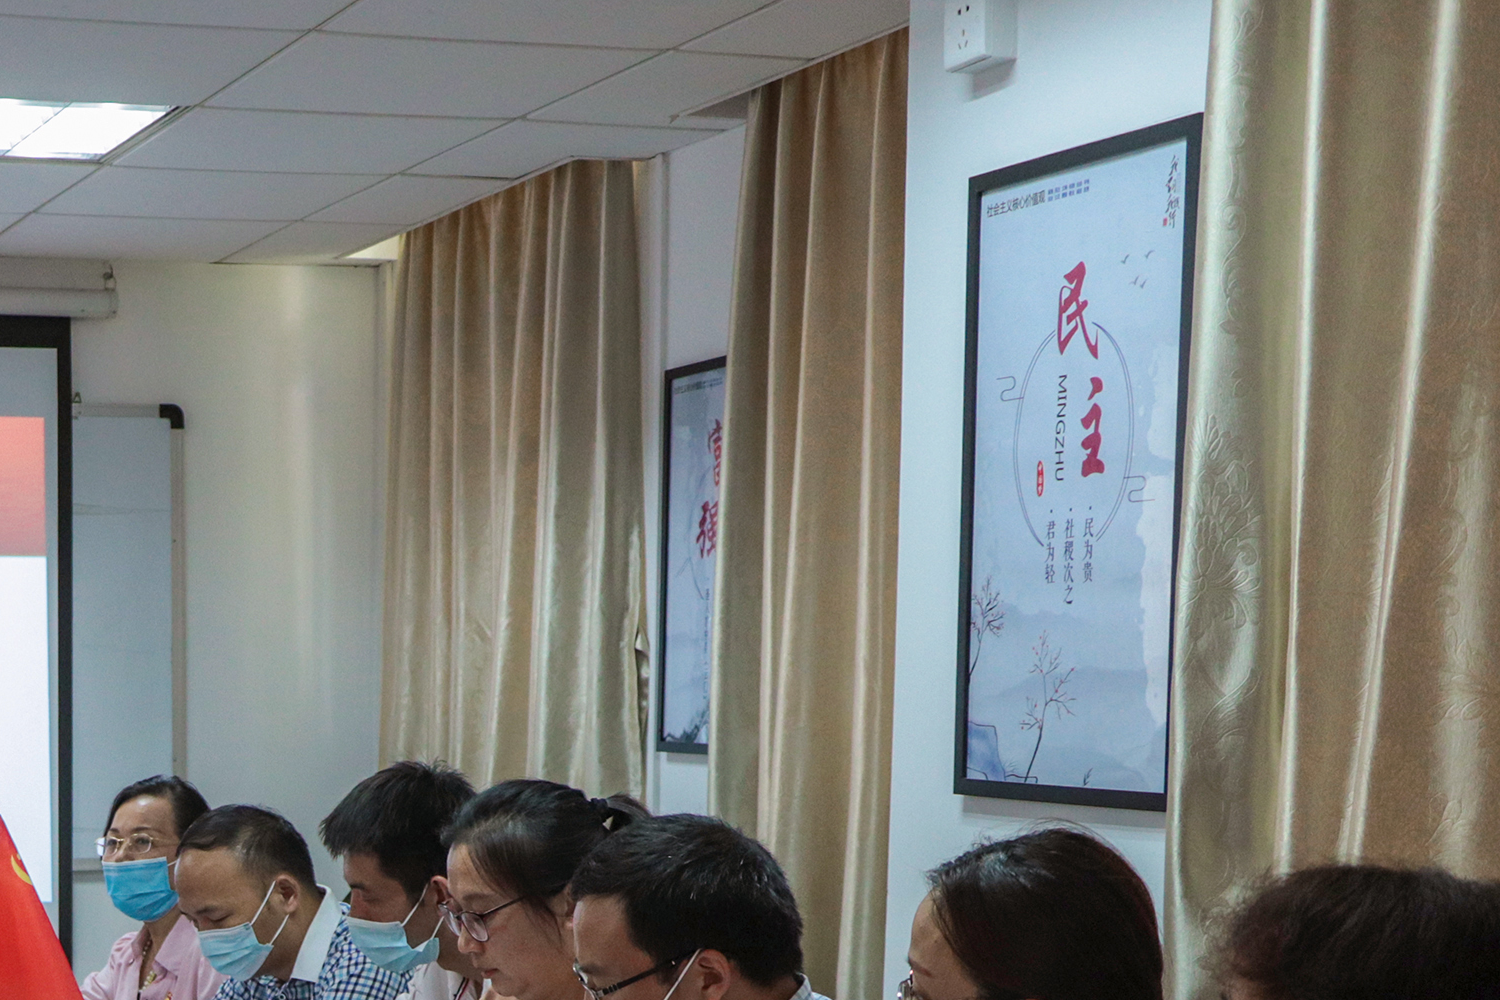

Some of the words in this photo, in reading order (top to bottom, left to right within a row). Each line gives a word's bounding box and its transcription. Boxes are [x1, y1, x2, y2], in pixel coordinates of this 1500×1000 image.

[1057, 260, 1105, 478] 民主
[1054, 374, 1067, 482] MINGZHU
[1044, 520, 1056, 584] 君为轻
[1063, 518, 1075, 604] 社稷次之
[1082, 517, 1094, 584] 民为贵
